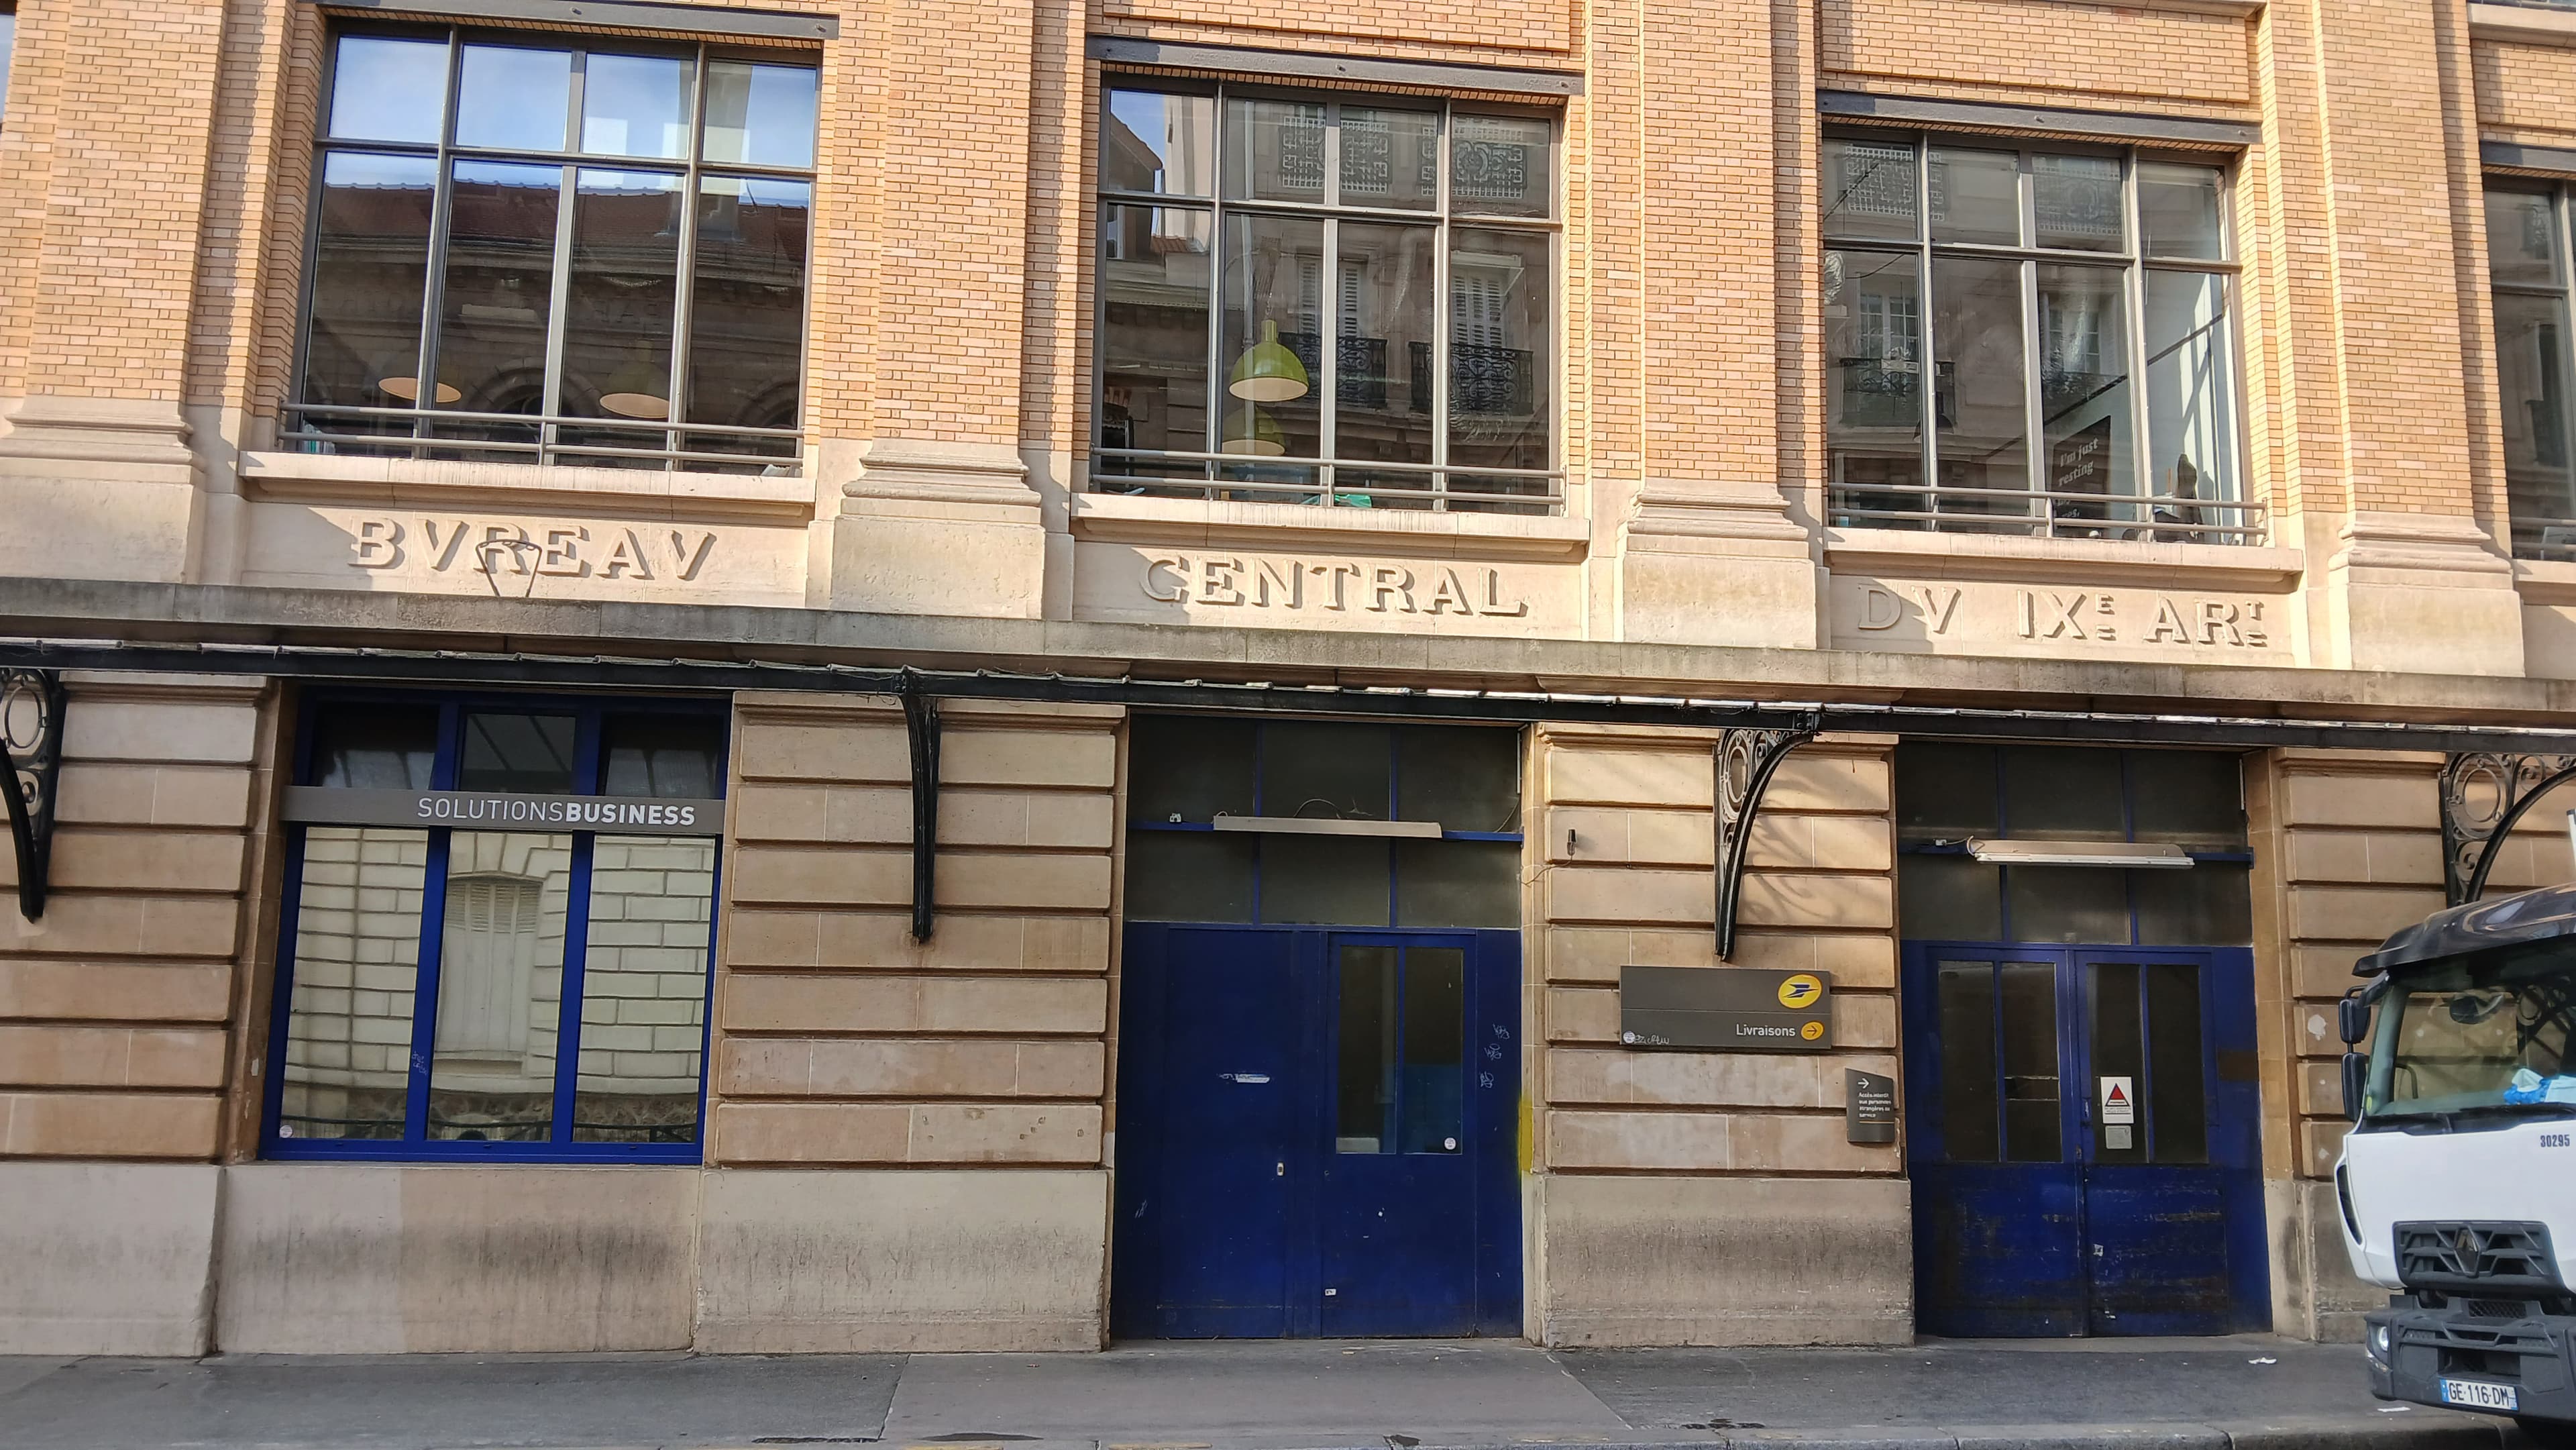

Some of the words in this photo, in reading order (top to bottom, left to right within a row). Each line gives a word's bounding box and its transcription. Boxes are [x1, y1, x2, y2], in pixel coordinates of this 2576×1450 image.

[2060, 452, 2076, 468] I'm
[2078, 437, 2098, 461] just
[2058, 461, 2094, 486] resting
[347, 515, 717, 582] BVREAV
[1140, 555, 1528, 618] CENTRAL
[1857, 584, 1962, 635] DV
[1736, 1024, 1795, 1037] Livraisons
[2540, 1134, 2571, 1147] 30295
